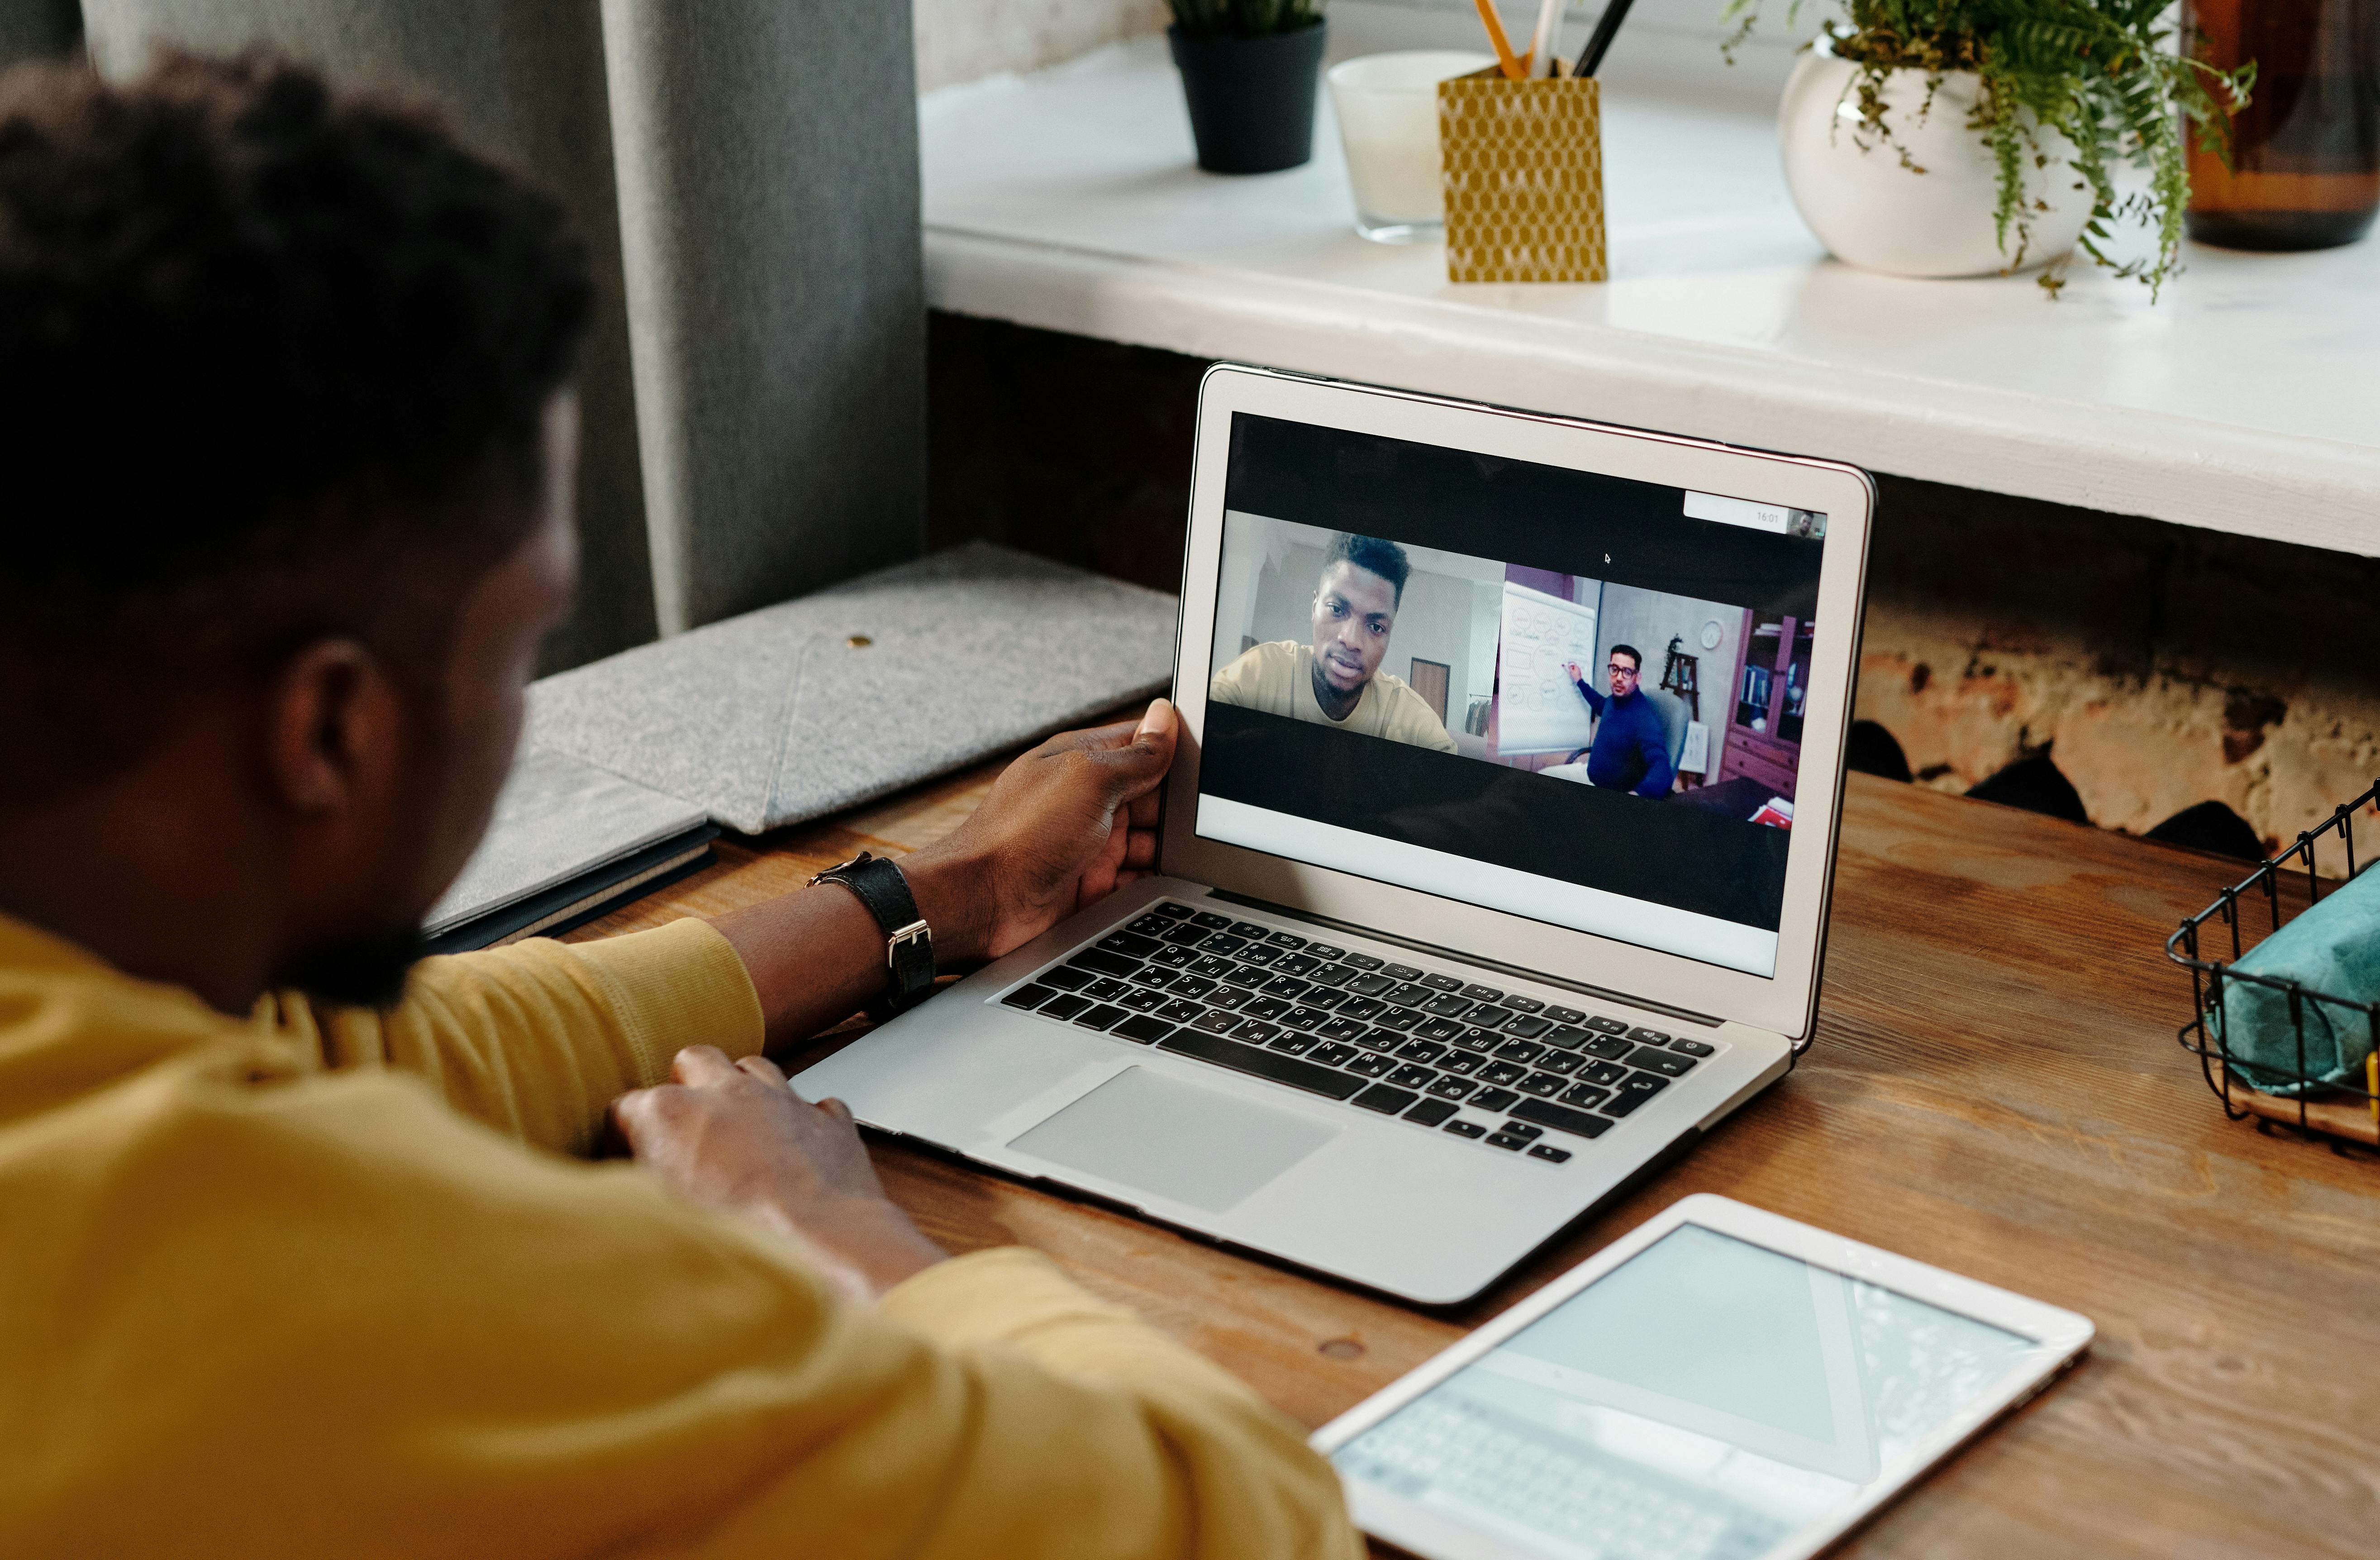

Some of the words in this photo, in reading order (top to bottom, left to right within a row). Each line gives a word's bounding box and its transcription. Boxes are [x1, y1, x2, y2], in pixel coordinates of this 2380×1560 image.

[1757, 512, 1778, 523] 16:01
[1471, 1040, 1488, 1048] Щ
[1449, 1050, 1457, 1058] L
[1453, 1062, 1470, 1071] Д
[1495, 1073, 1511, 1081] Ж
[1445, 1087, 1461, 1095] Ю
